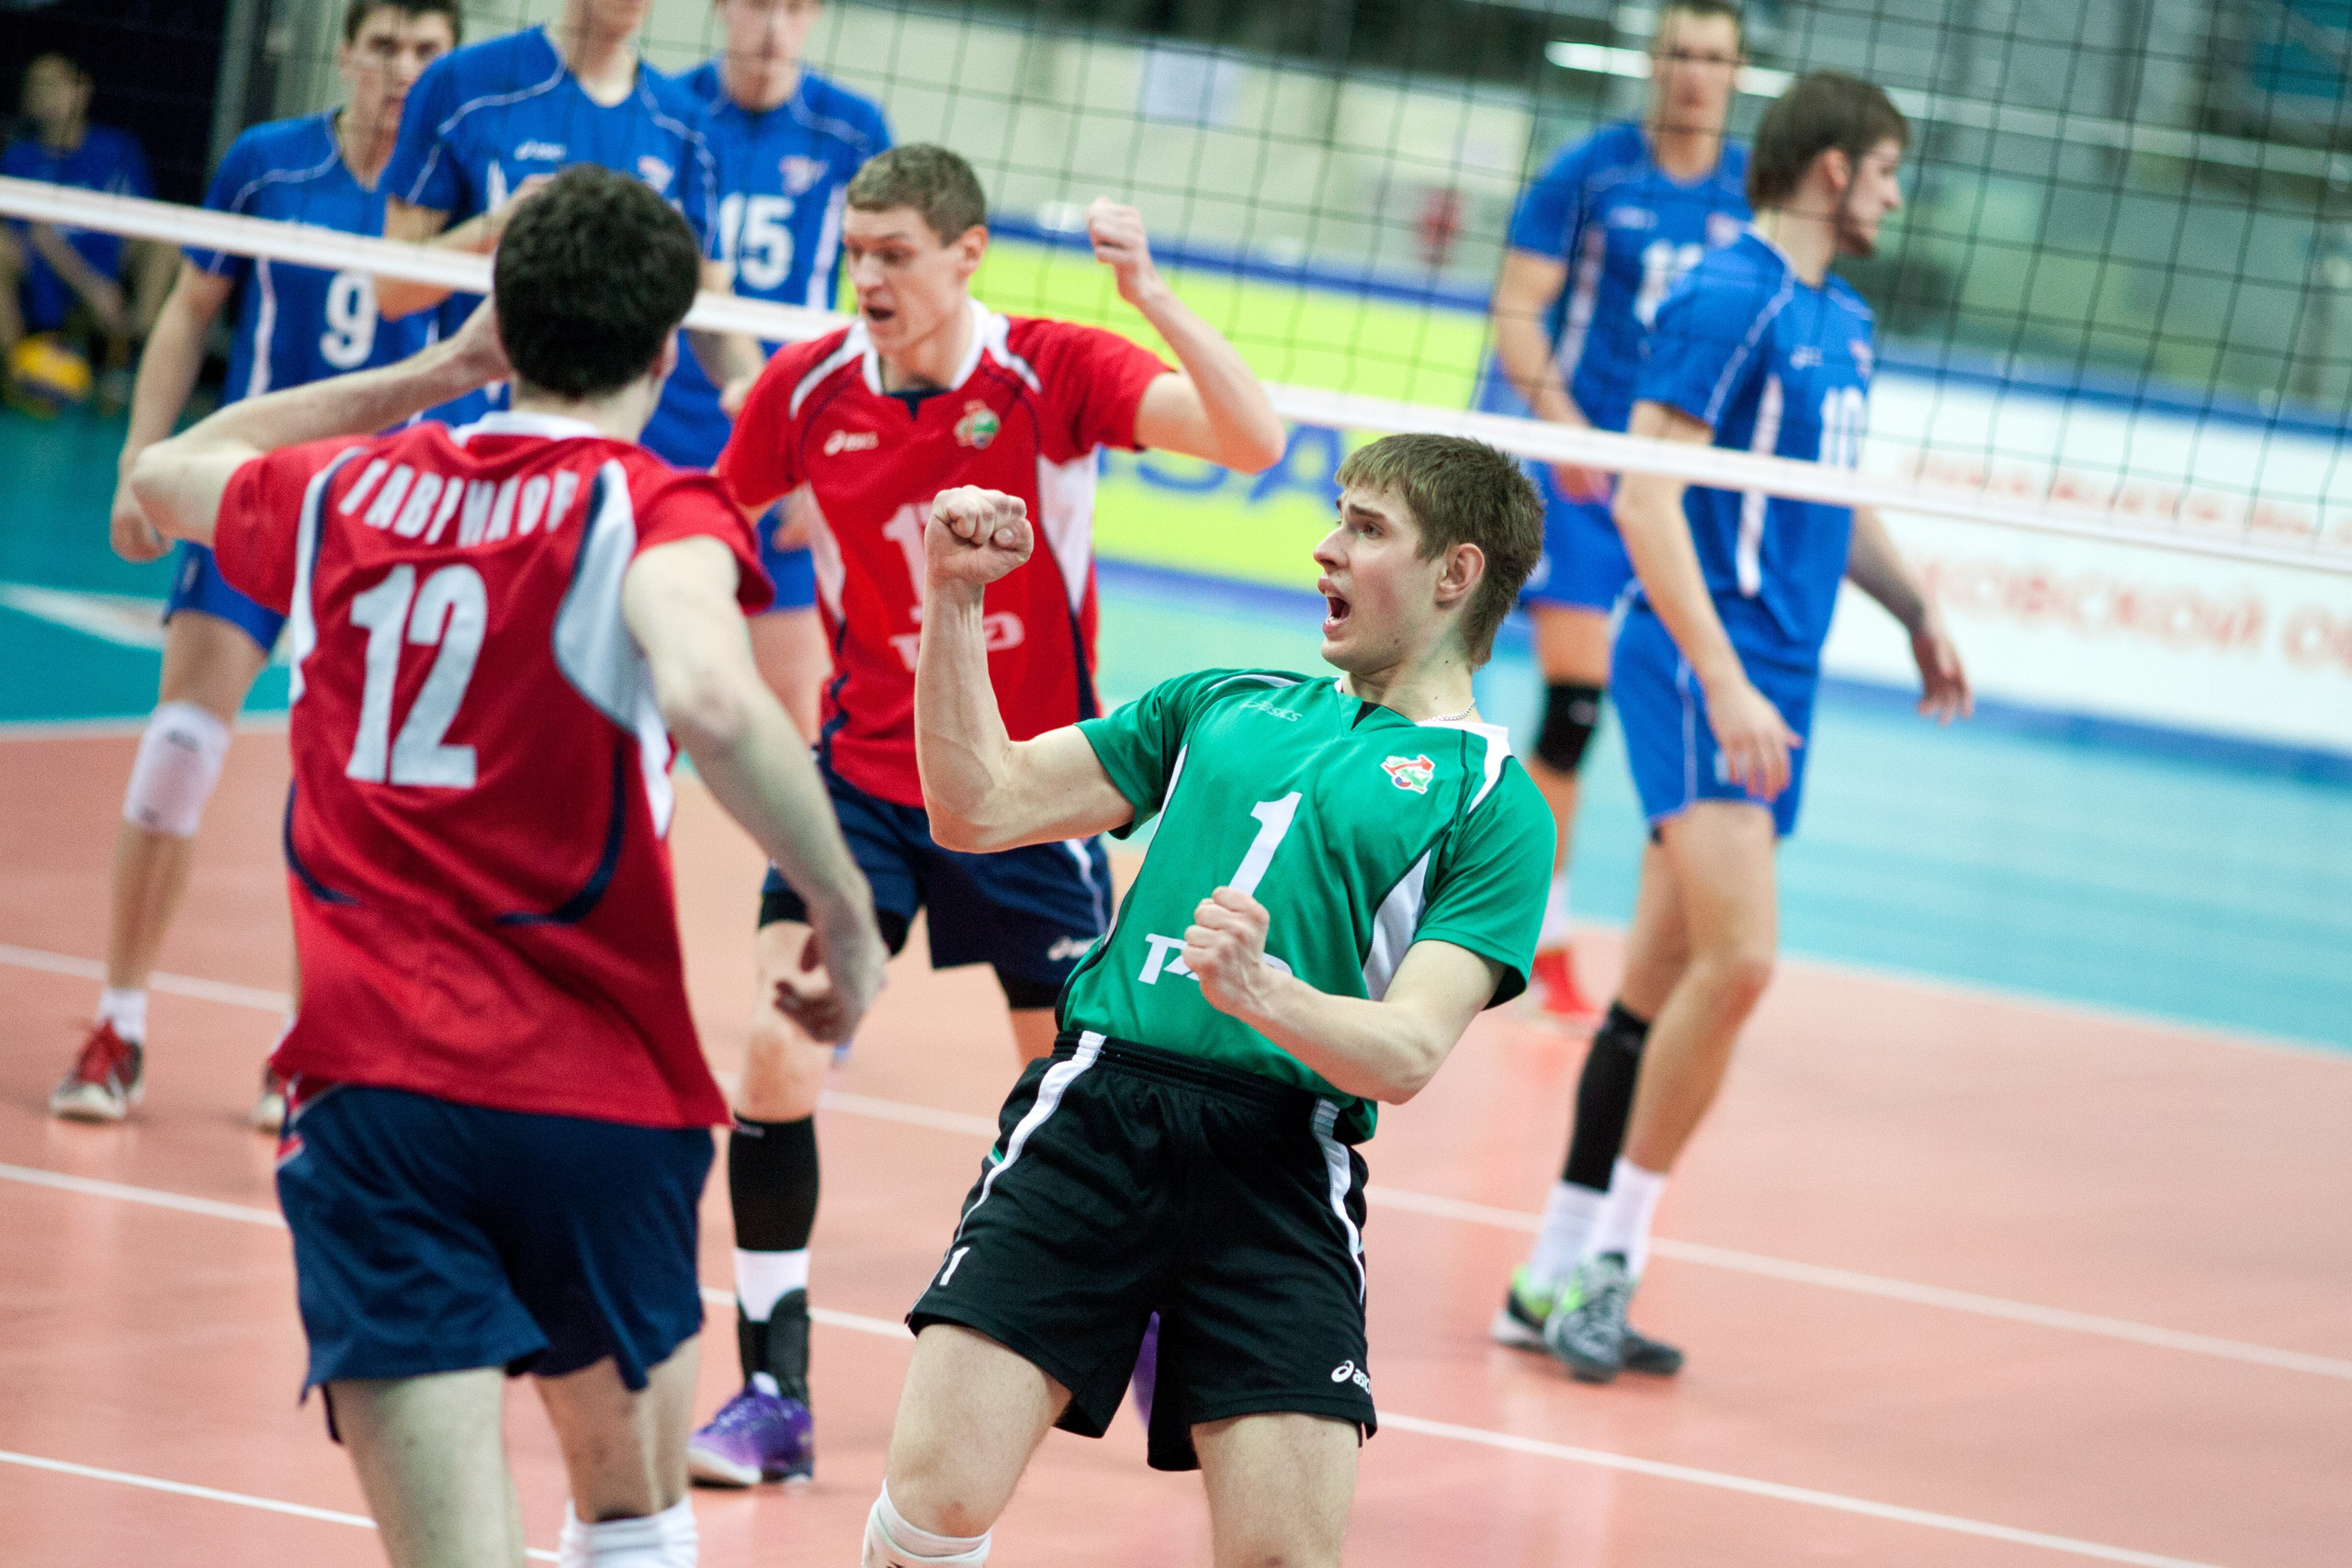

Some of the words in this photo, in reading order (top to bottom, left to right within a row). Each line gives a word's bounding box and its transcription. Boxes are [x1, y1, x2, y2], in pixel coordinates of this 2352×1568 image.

[719, 192, 796, 291] 15
[320, 271, 378, 369] 9
[345, 563, 488, 789] 12
[1227, 791, 1303, 897] 1
[939, 1246, 970, 1286] 1
